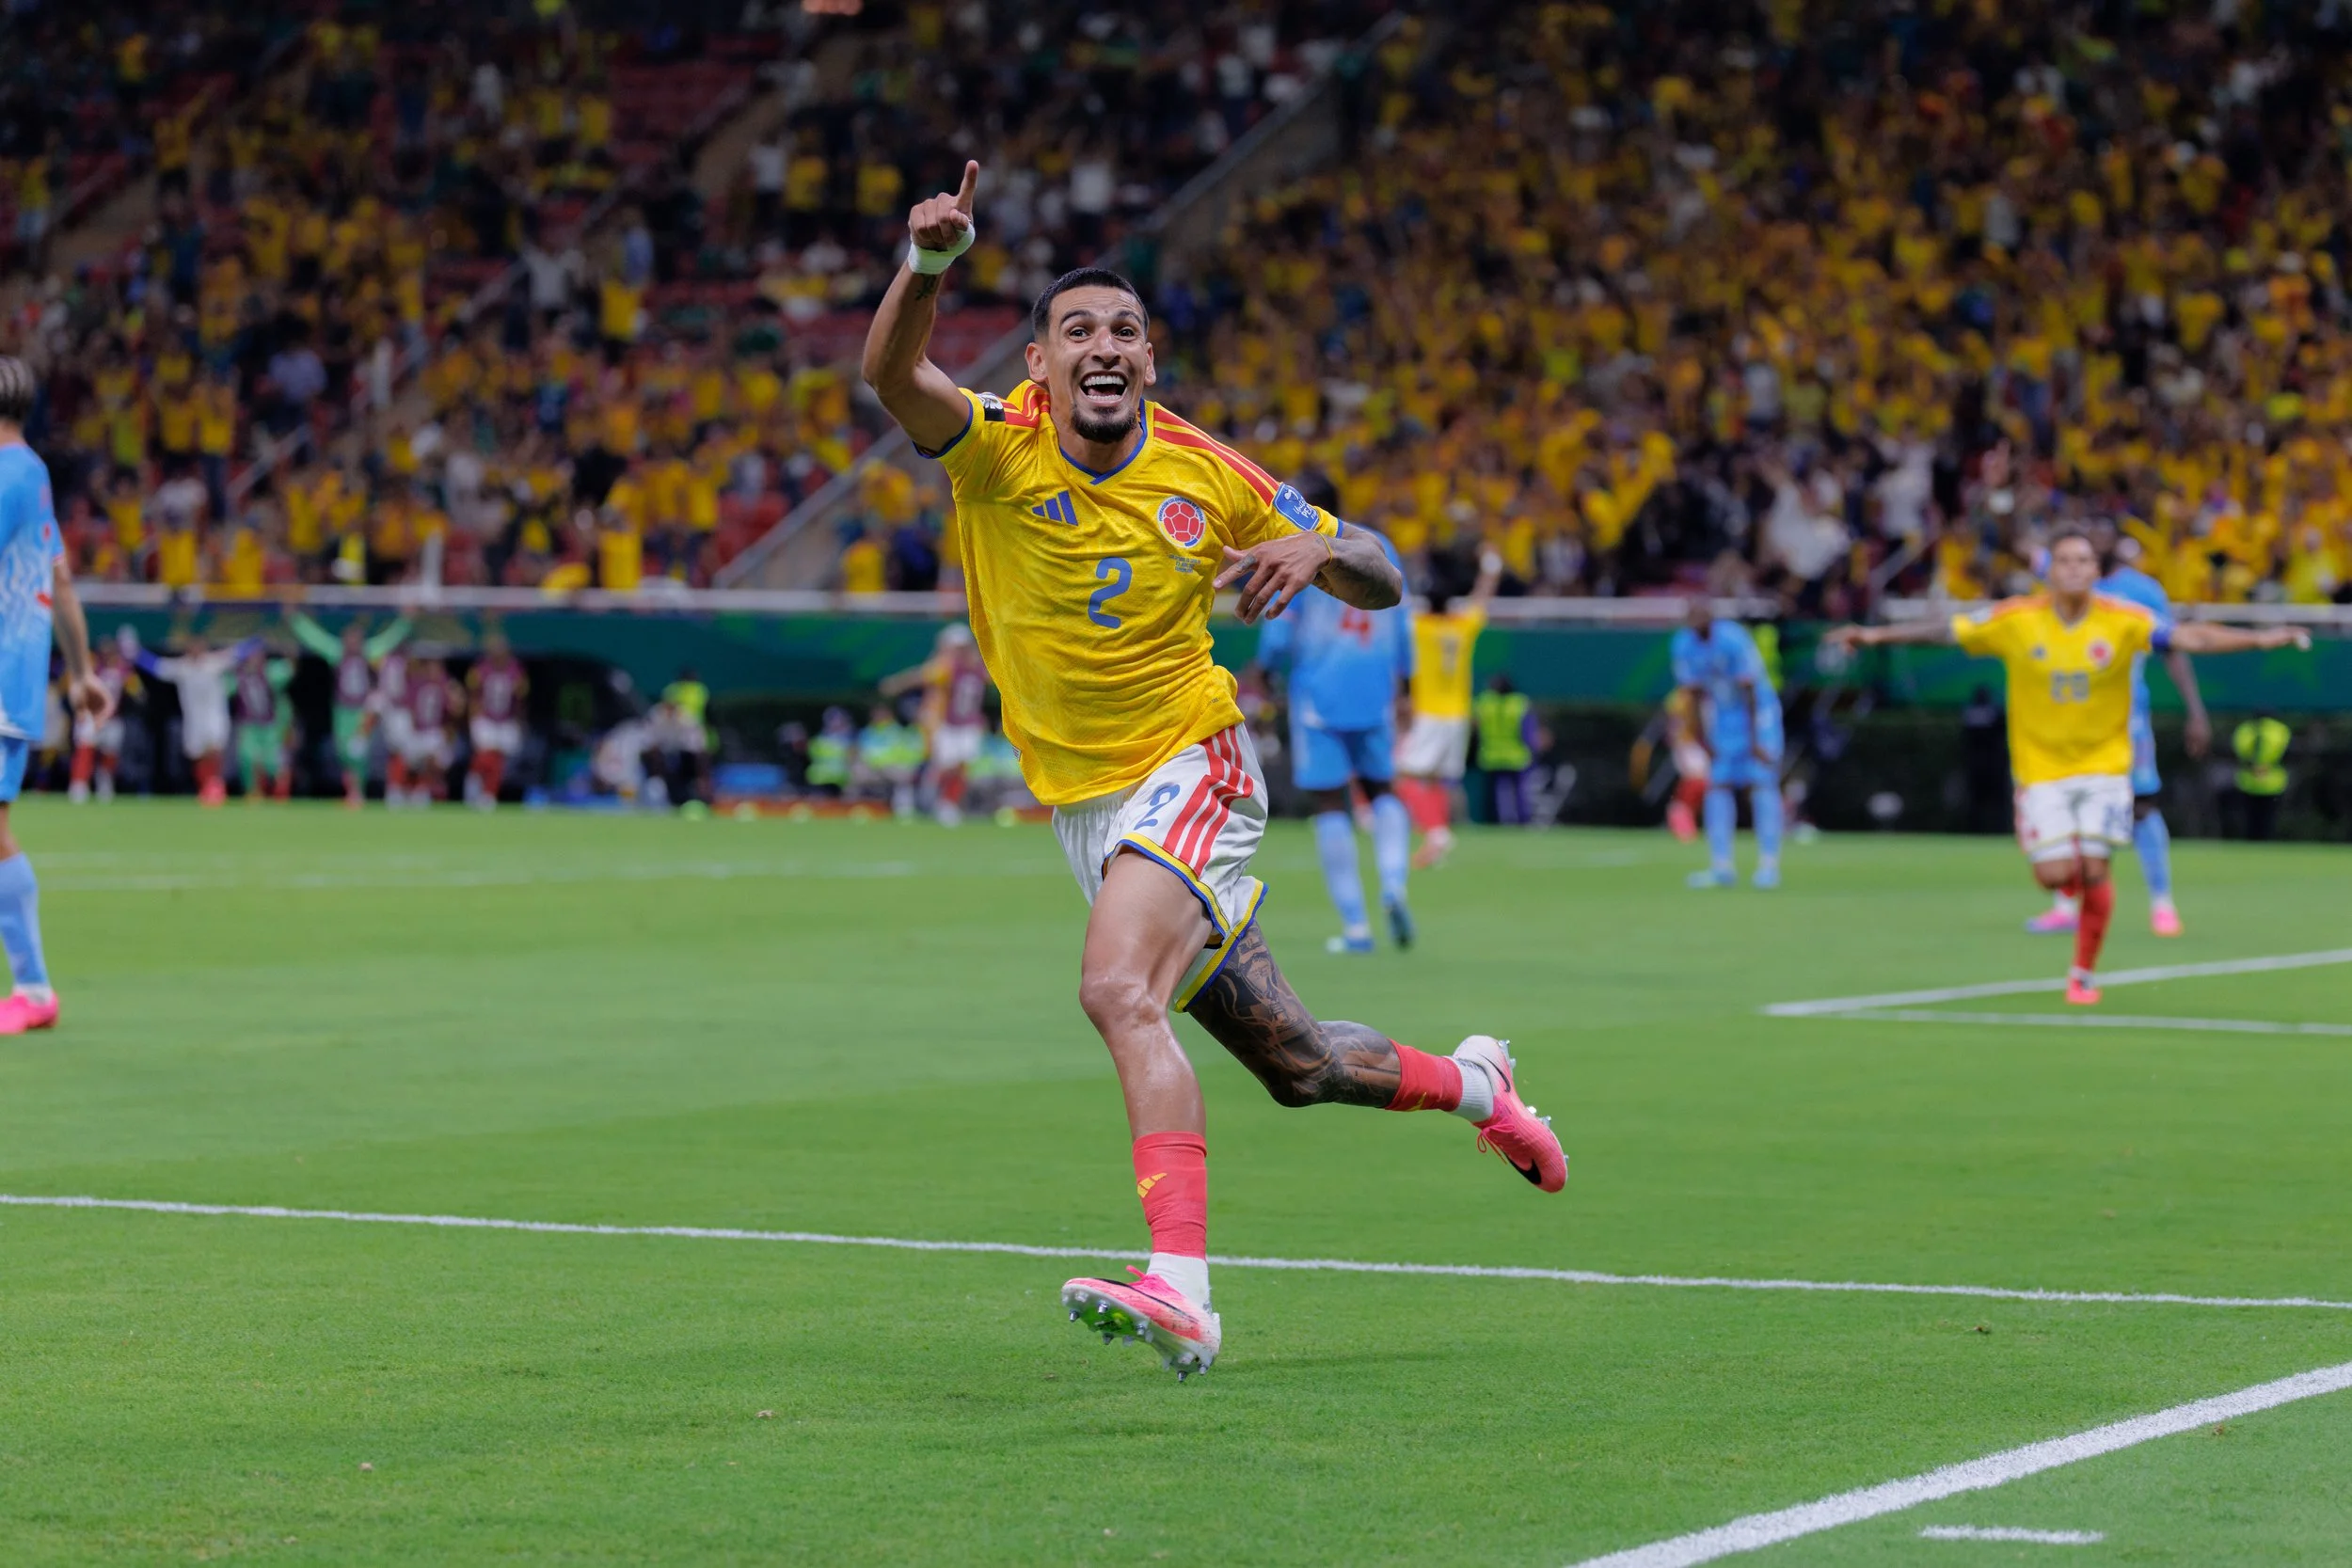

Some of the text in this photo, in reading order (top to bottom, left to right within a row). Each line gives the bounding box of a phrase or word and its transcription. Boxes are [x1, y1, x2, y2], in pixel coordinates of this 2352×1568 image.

[1088, 556, 1133, 629] 2
[1337, 603, 1373, 649] 4
[1134, 782, 1181, 831] 2
